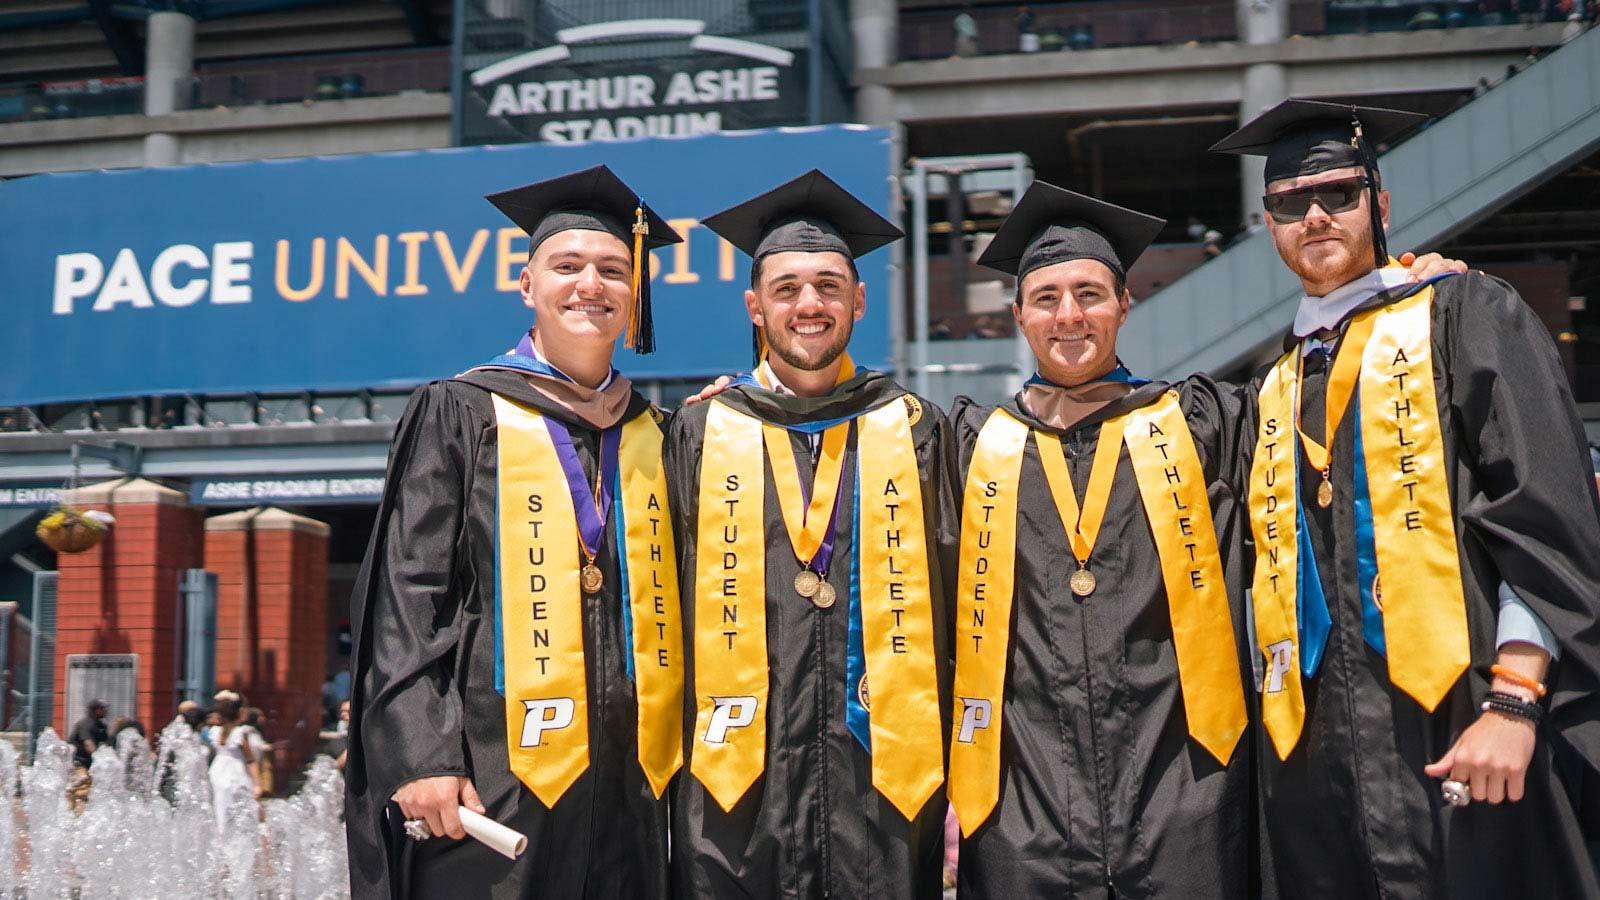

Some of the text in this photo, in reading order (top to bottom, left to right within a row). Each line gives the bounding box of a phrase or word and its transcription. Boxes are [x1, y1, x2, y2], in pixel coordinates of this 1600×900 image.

[487, 67, 780, 117] ARTHUR ASHE
[540, 112, 722, 143] STADIUM
[52, 218, 735, 315] PACE UNIVEI
[1149, 421, 1205, 589] ATHLETE
[1264, 417, 1280, 594] STUDENT
[1392, 347, 1422, 532] ATHLETE
[527, 494, 550, 676] STUDENT
[647, 493, 669, 668] ATHLETE
[723, 474, 740, 651] STUDENT
[884, 478, 907, 655] ATHLETE
[972, 481, 998, 654] STUDENT
[519, 697, 575, 748] P
[704, 695, 759, 744] P
[955, 696, 993, 744] P
